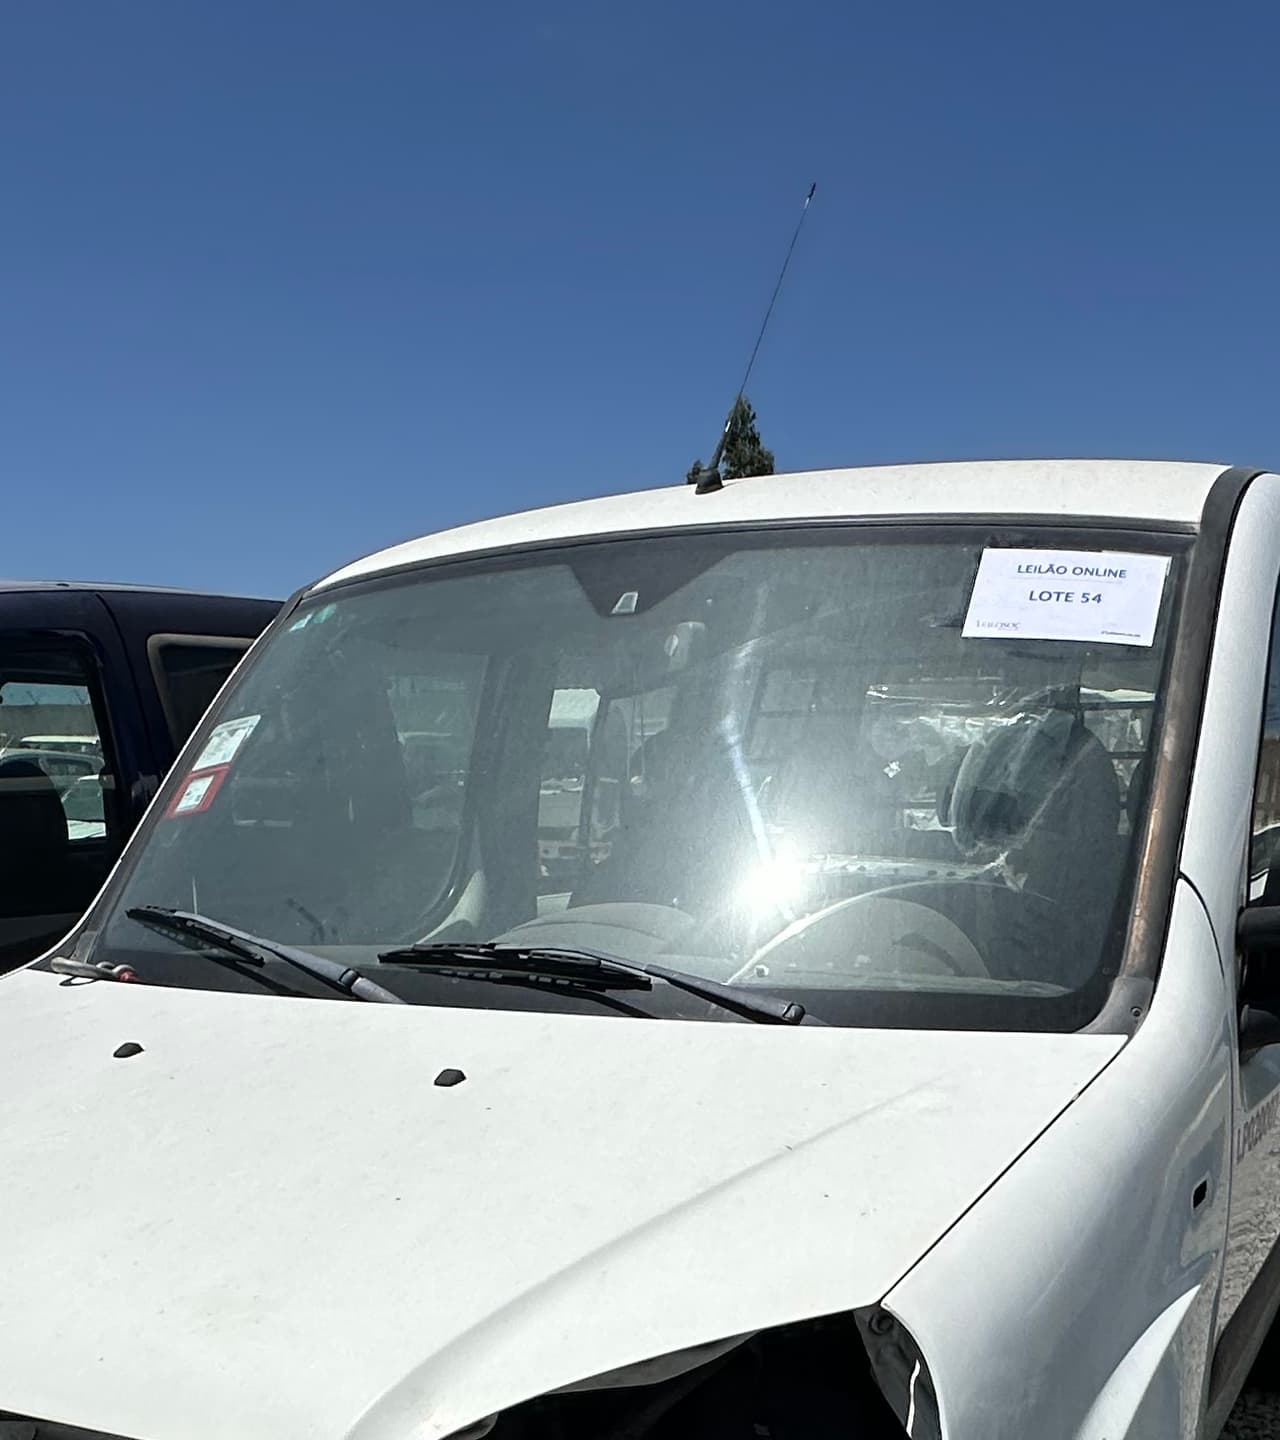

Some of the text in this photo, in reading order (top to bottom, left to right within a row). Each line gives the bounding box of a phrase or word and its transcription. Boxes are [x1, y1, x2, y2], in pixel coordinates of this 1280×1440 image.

[1017, 564, 1127, 578] LEILÃO ONLINE
[1028, 590, 1102, 604] LOTE 54
